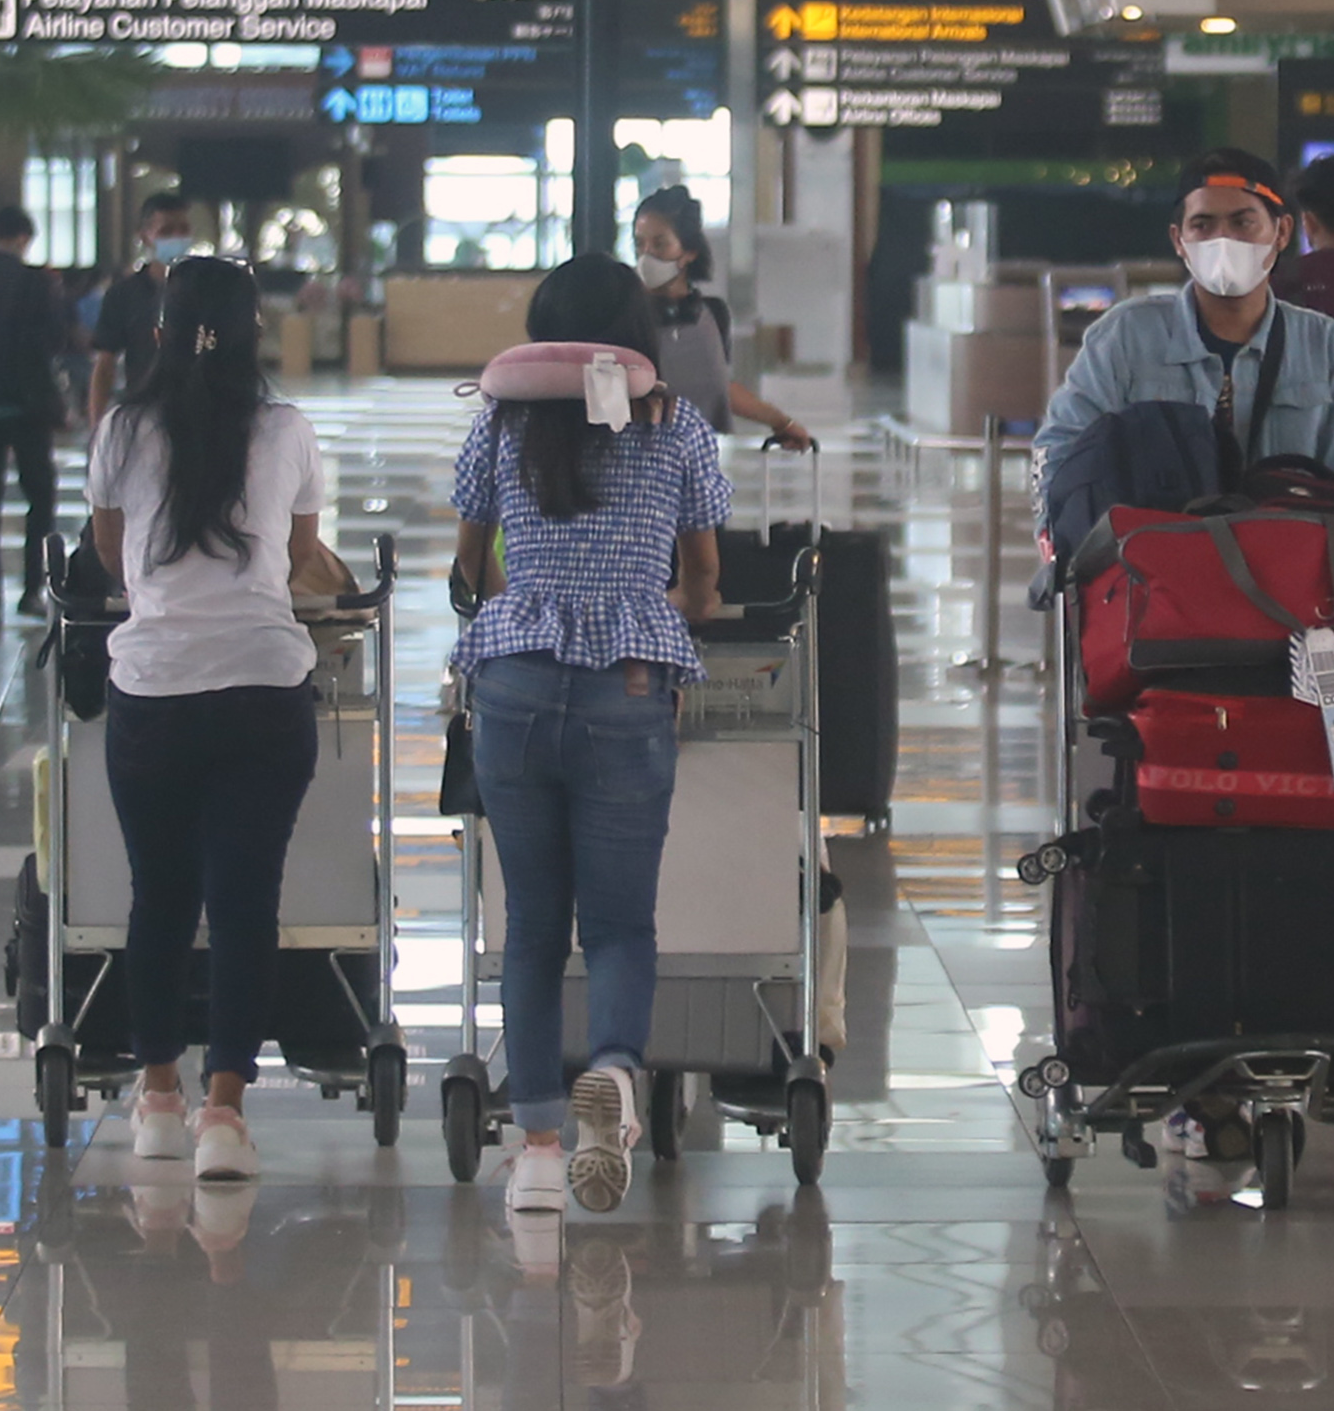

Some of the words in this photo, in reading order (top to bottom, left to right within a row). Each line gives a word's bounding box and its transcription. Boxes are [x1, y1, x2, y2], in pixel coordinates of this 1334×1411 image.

[23, 13, 105, 40] Airline
[108, 11, 236, 40] Customer
[238, 13, 337, 40] Service
[1148, 765, 1239, 793] POLO
